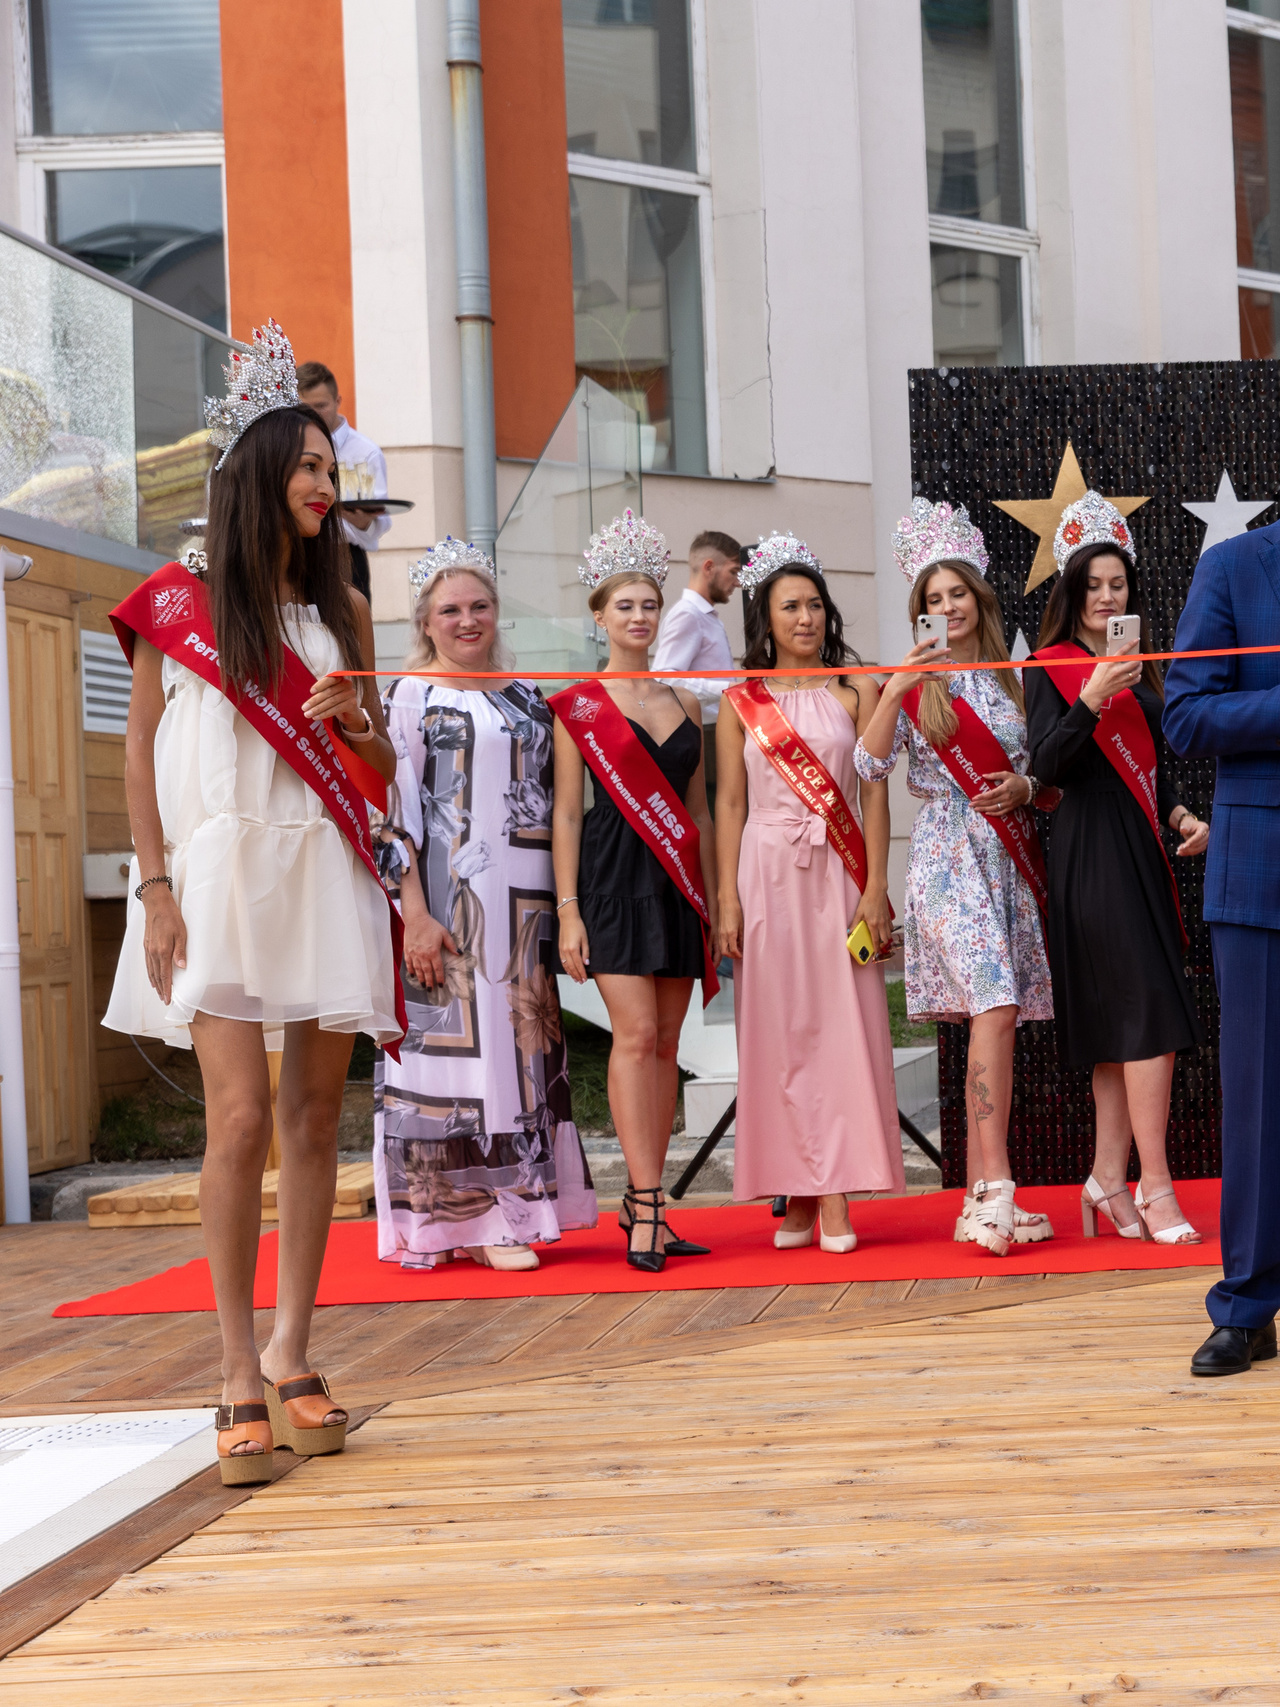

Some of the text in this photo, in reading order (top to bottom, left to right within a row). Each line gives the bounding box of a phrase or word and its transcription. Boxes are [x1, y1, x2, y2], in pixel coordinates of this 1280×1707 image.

[184, 632, 221, 668] Perf
[243, 679, 297, 739] Women
[296, 737, 331, 782] Saint
[950, 744, 982, 785] Perfect
[1111, 733, 1139, 773] Perfect
[584, 731, 613, 773] Perfect
[610, 770, 641, 812] Women
[639, 809, 664, 840] Saint
[661, 837, 694, 896] Petersburg
[647, 791, 686, 840] MISS
[754, 726, 859, 870] Perfect Women Saint Petersburg 2022
[790, 746, 826, 790] VICE
[821, 788, 852, 835] MISS
[1006, 818, 1020, 840] LO
[1016, 839, 1035, 876] region
